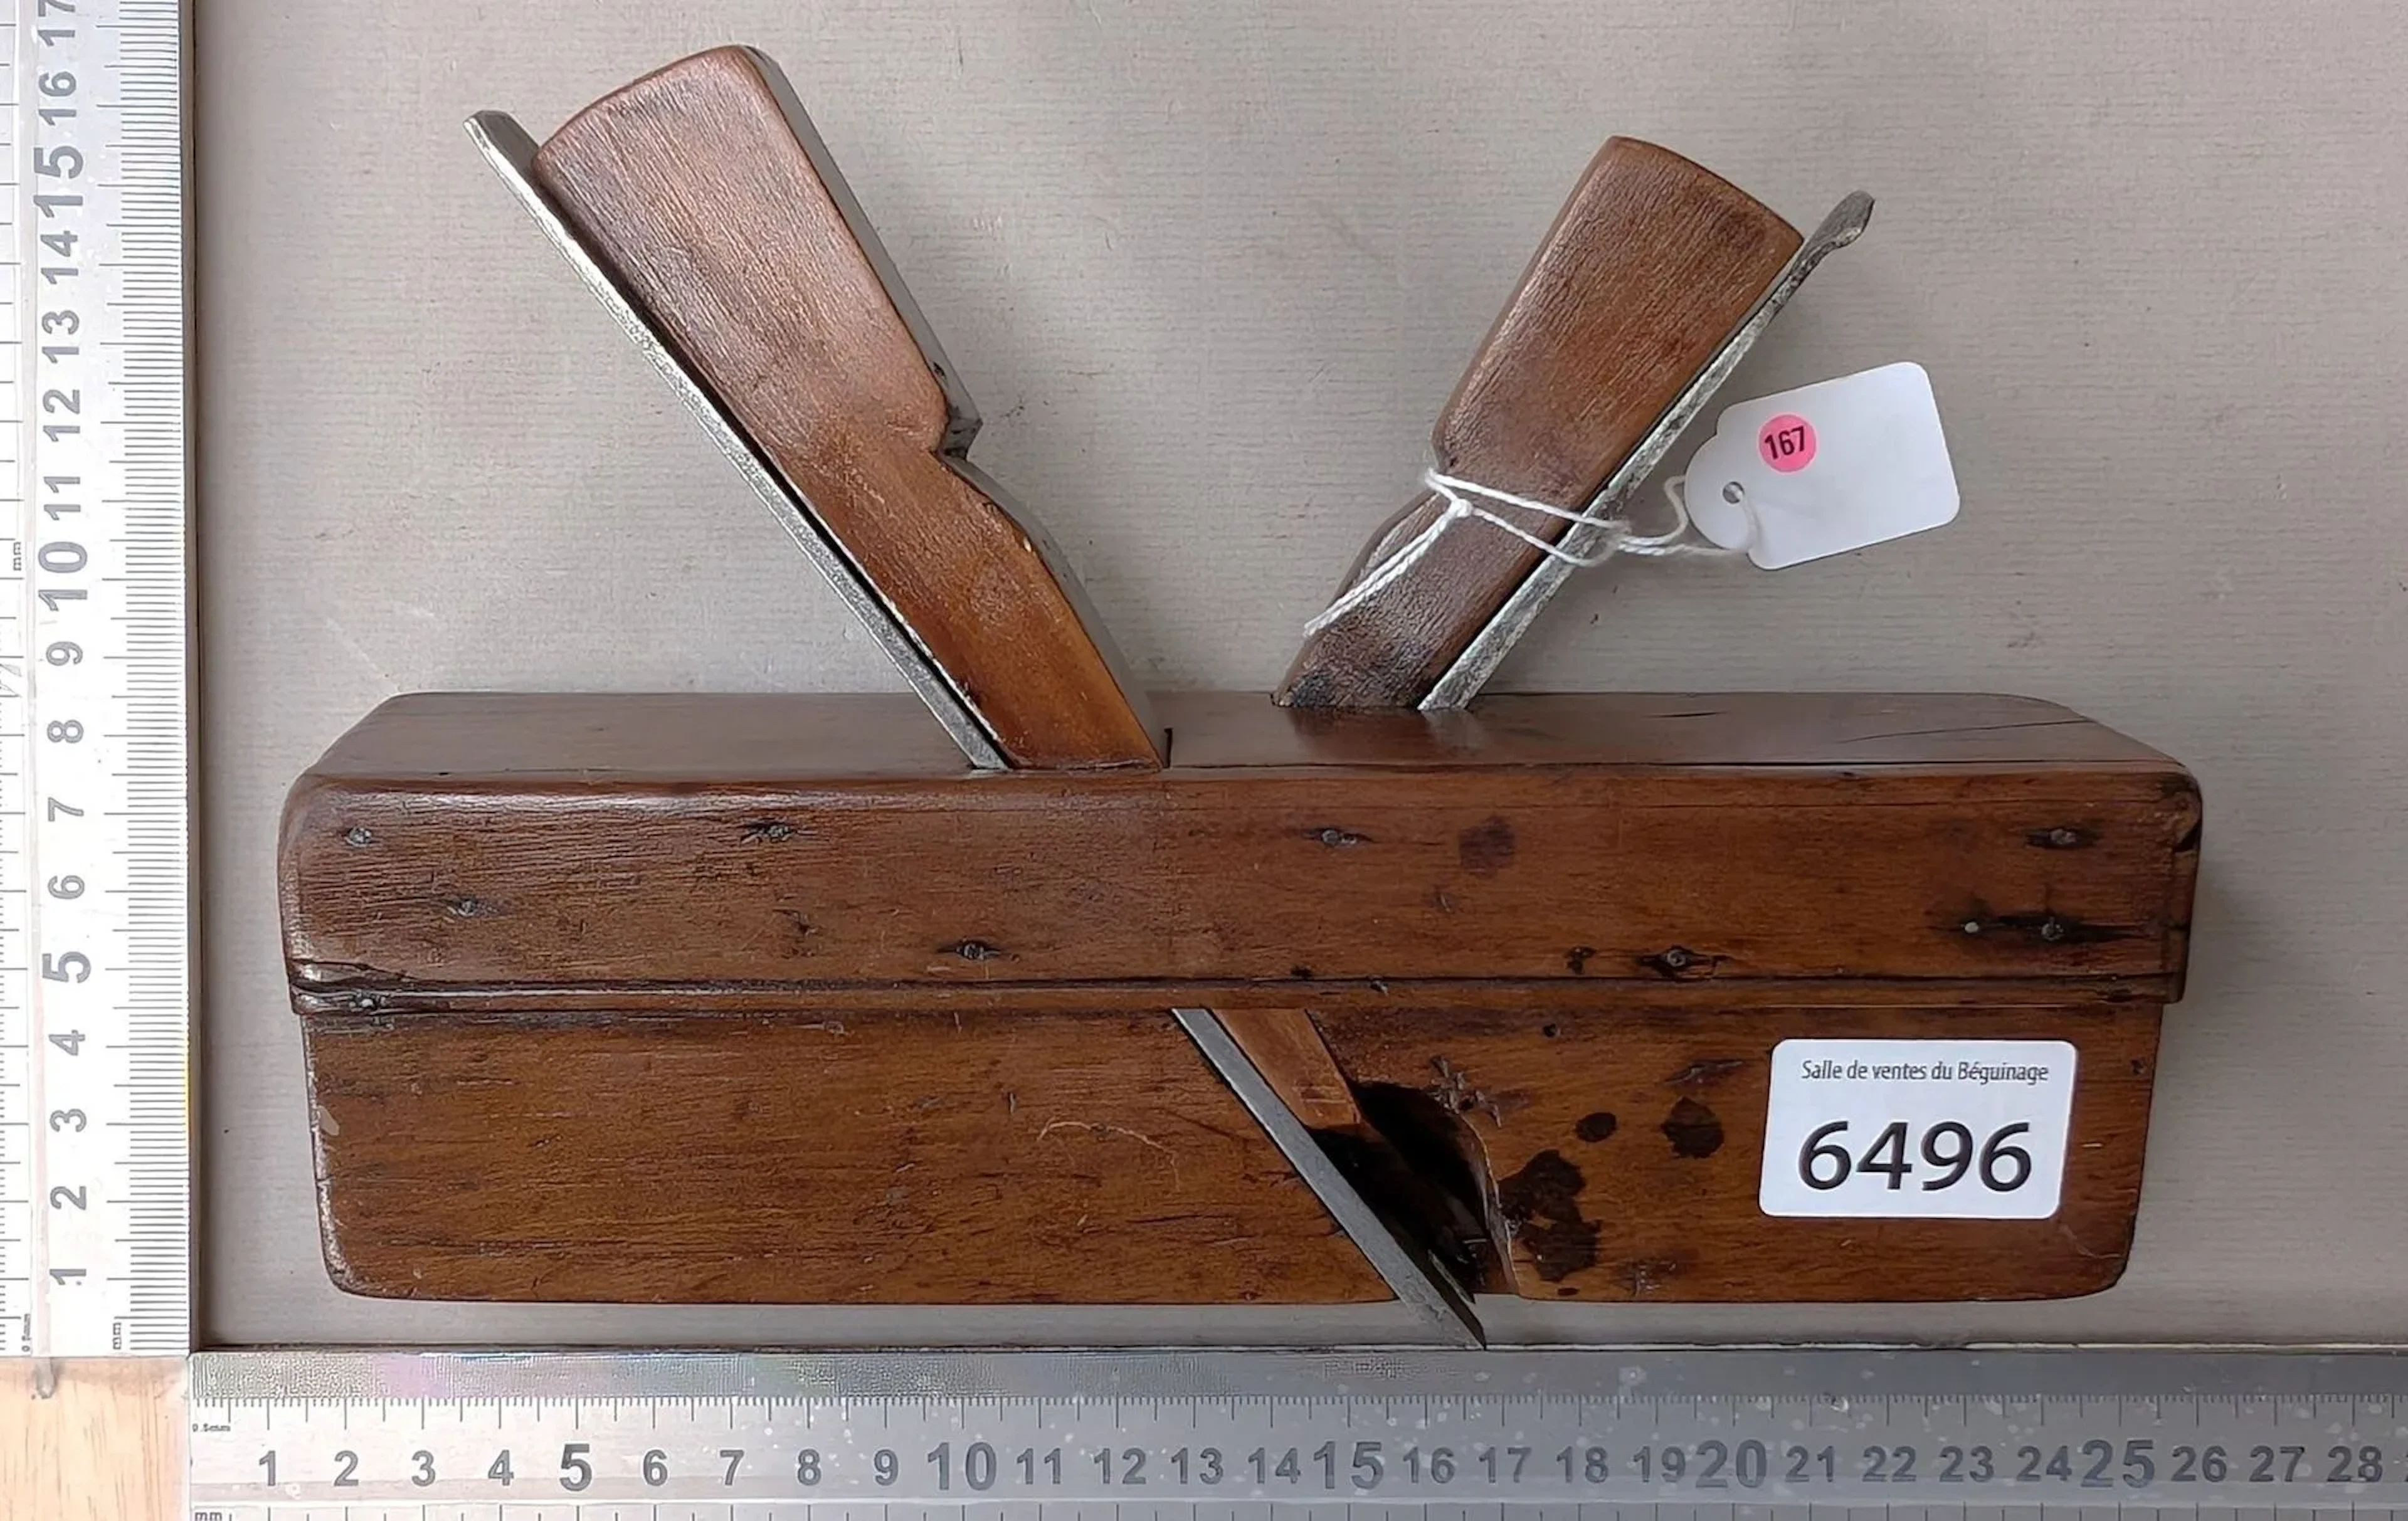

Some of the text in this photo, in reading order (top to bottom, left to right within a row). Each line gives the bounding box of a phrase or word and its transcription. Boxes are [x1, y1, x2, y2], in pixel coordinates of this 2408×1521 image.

[38, 71, 77, 126] 16
[33, 145, 84, 218] 15
[40, 231, 78, 285] 14
[41, 310, 80, 364] 13
[43, 389, 80, 443] 12
[1763, 426, 1807, 460] 167
[43, 476, 81, 521] 11
[38, 541, 88, 612] 10
[45, 641, 83, 666] 9
[47, 720, 84, 744] 8
[48, 797, 85, 822] 7
[48, 875, 85, 900] 6
[42, 951, 92, 984] 5
[48, 1029, 86, 1056] 4
[1801, 1059, 2049, 1086] Salle de ventes du Béguinage
[50, 1108, 87, 1133] 3
[1798, 1120, 2032, 1192] 6496
[50, 1186, 87, 1211] 2
[49, 1268, 87, 1286] 1
[112, 1322, 122, 1350] mm
[258, 1450, 277, 1487] 1
[334, 1450, 359, 1487] 2
[411, 1450, 436, 1487] 3
[488, 1450, 514, 1486] 4
[559, 1443, 593, 1492] 5
[643, 1450, 668, 1486] 6
[719, 1450, 745, 1485] 7
[797, 1449, 821, 1486] 8
[874, 1449, 898, 1486] 9
[927, 1442, 997, 1491] 10
[1016, 1448, 1062, 1485] 11
[1094, 1448, 1147, 1485] 12
[1171, 1448, 1224, 1485] 13
[1248, 1447, 1301, 1484] 14
[1314, 1441, 1384, 1490] 15
[1403, 1446, 1455, 1483] 16
[1479, 1447, 1532, 1483] 17
[1556, 1446, 1610, 1483] 18
[1633, 1446, 1686, 1483] 19
[1696, 1439, 1768, 1488] 20
[1785, 1446, 1835, 1482] 21
[1862, 1445, 1917, 1482] 22
[1939, 1446, 1995, 1483] 23
[2015, 1445, 2073, 1482] 24
[2081, 1439, 2155, 1488] 25
[2171, 1445, 2227, 1482] 26
[2249, 1445, 2305, 1482] 27
[2327, 1445, 2383, 1483] 28
